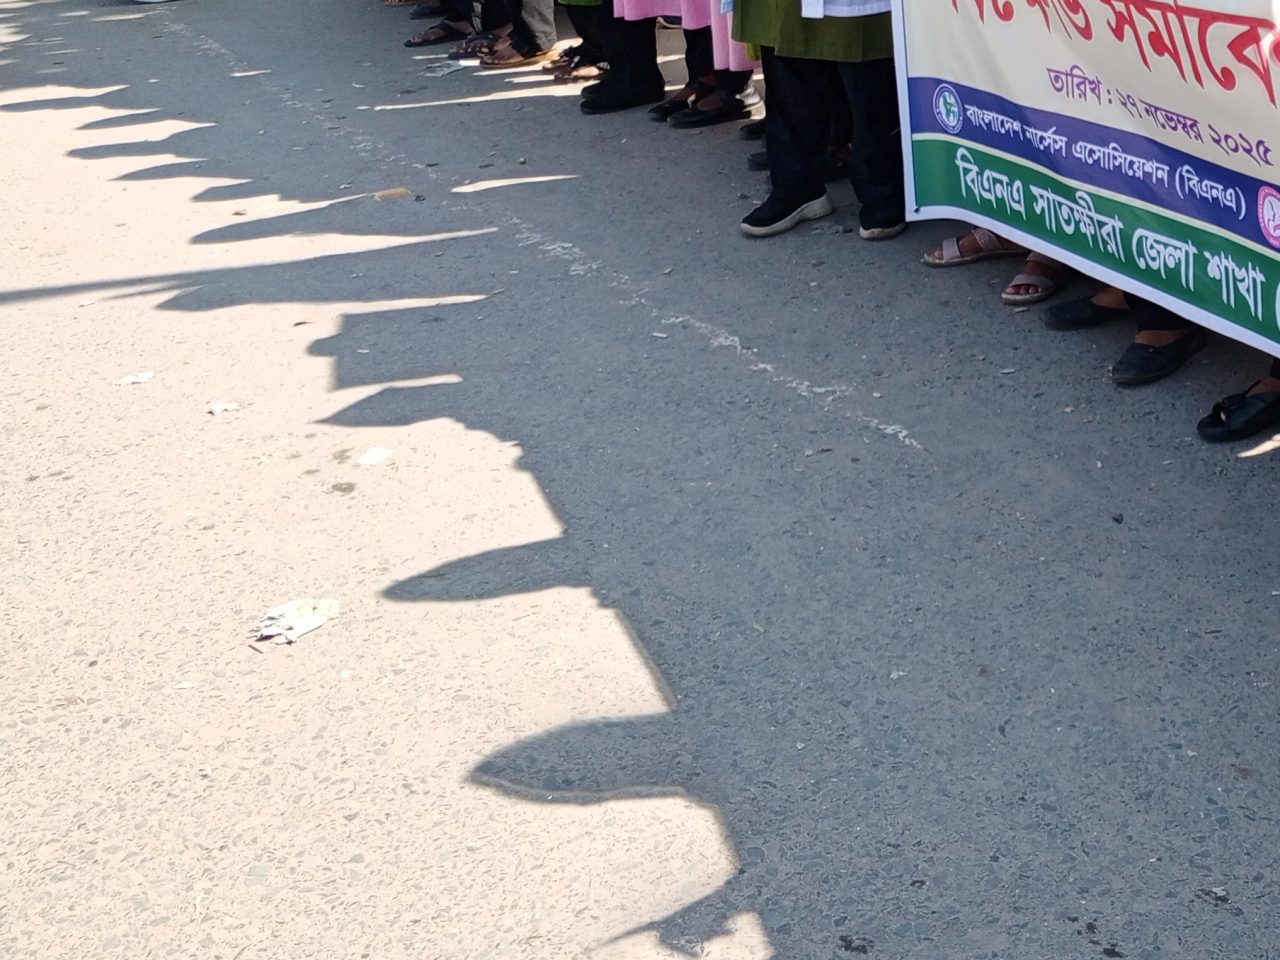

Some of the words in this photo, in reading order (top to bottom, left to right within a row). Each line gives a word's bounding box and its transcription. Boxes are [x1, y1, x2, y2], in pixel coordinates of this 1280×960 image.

[964, 103, 1023, 142] বাংলাদেশ
[1022, 121, 1068, 159] নার্সেস
[1072, 140, 1170, 190] এসোসিয়েশন
[1174, 164, 1248, 222] (বিএনএ)
[1047, 64, 1104, 106] তারিখ
[1117, 88, 1141, 120] ২৭
[1139, 96, 1205, 144] নভেম্বর
[1208, 122, 1274, 169] ২০২৫
[955, 146, 1029, 222] বিএনএ
[1029, 184, 1126, 264] সাতক্ষীরা
[1131, 226, 1199, 293] জেলা
[1203, 248, 1267, 321] শাখা
